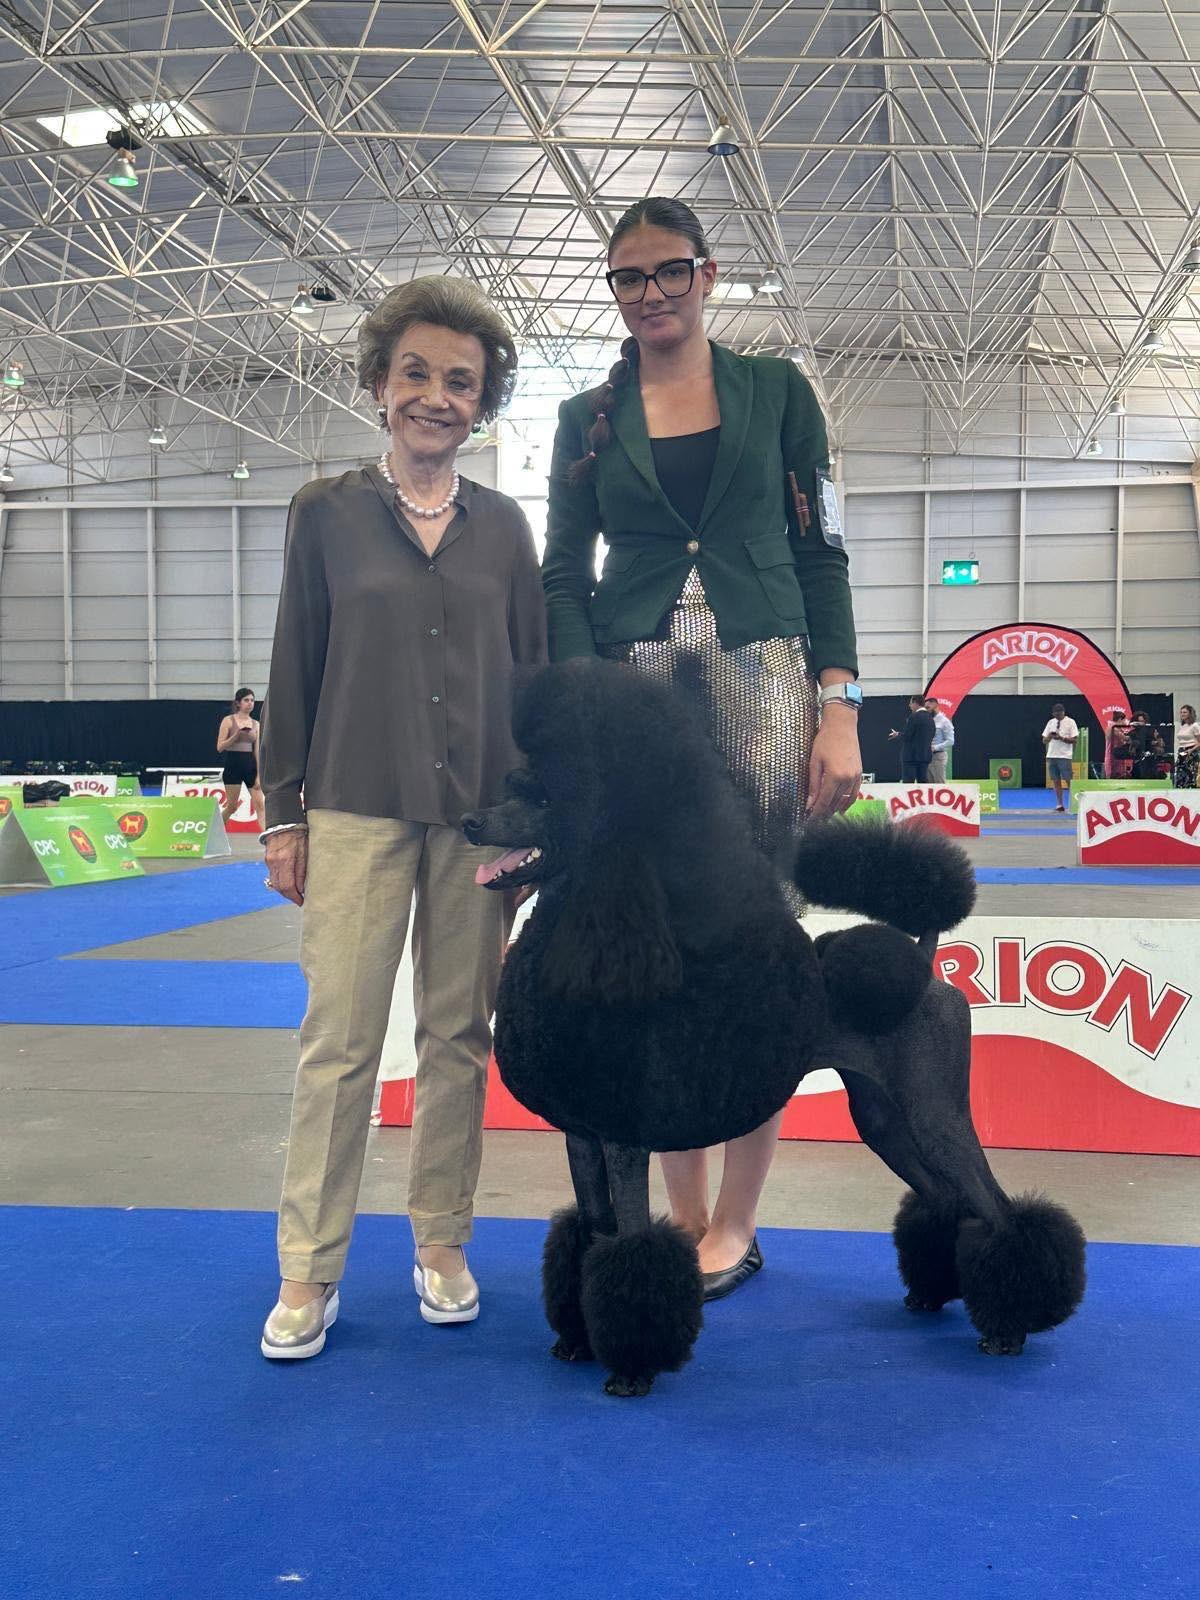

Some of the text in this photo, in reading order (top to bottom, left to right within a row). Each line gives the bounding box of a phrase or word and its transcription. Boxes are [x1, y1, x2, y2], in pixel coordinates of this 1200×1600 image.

[984, 631, 1079, 670] ARION
[70, 780, 109, 796] RION
[977, 792, 996, 801] CPC
[890, 787, 975, 818] ARION
[1085, 796, 1200, 840] ARION
[172, 821, 207, 834] CPC
[33, 839, 61, 856] CPC
[104, 832, 128, 850] CPC
[932, 936, 1192, 1061] RION
